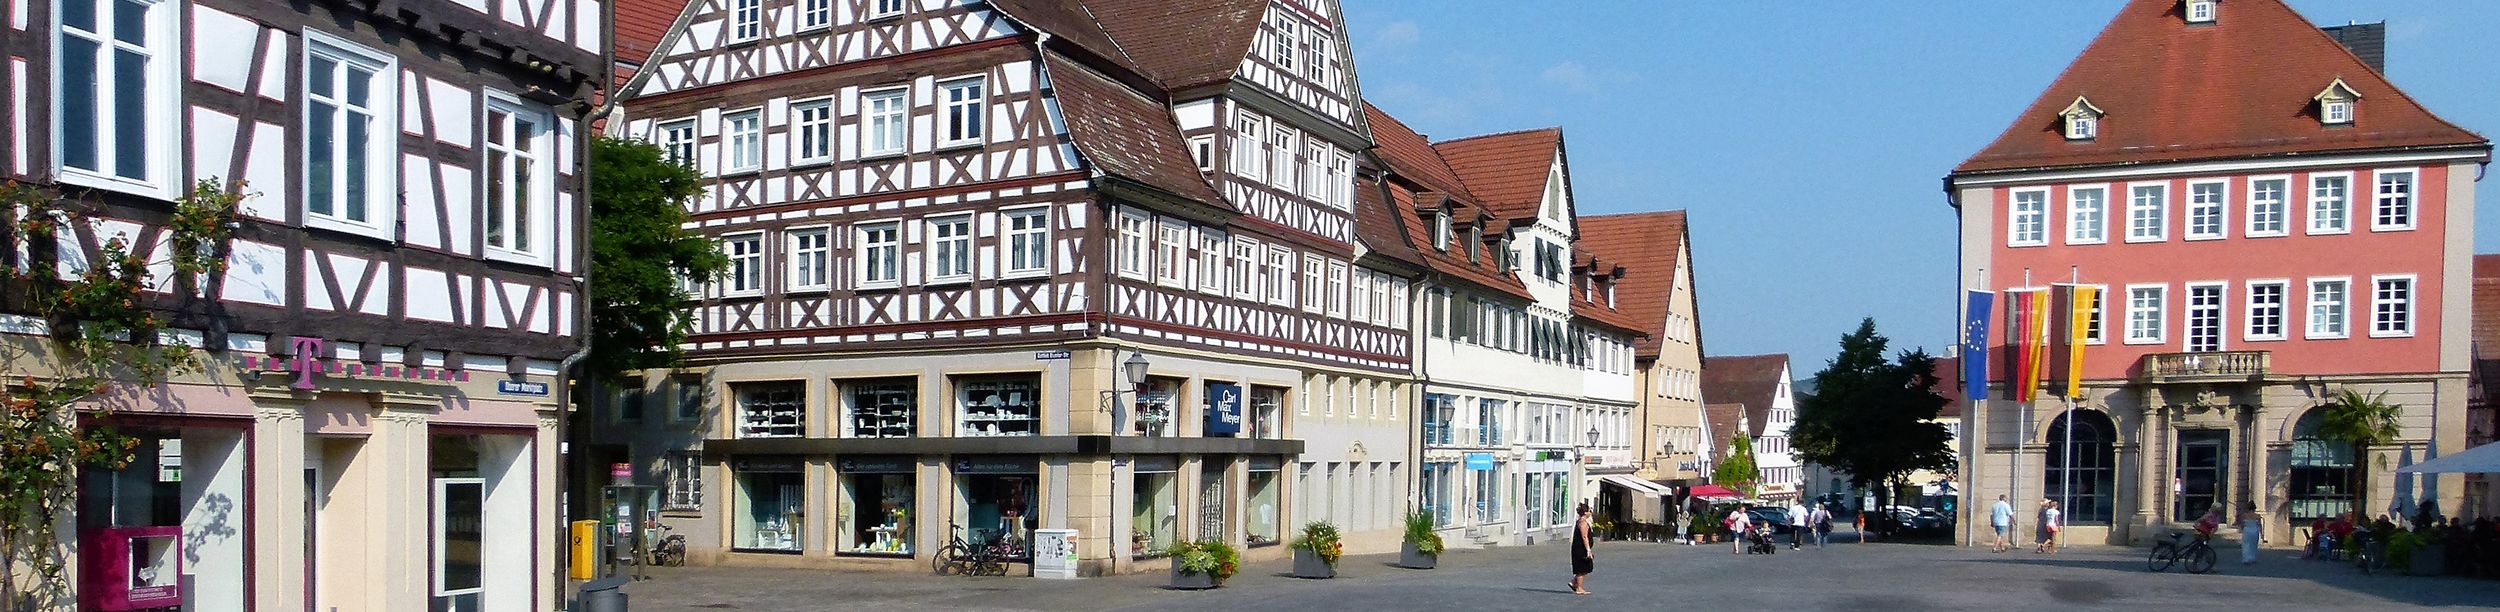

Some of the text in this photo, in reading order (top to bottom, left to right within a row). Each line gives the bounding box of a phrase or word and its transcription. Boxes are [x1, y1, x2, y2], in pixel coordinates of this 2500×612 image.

[291, 336, 323, 388] T
[1222, 389, 1237, 403] Carl
[1217, 400, 1232, 412] Max
[1221, 411, 1240, 425] Meyer
